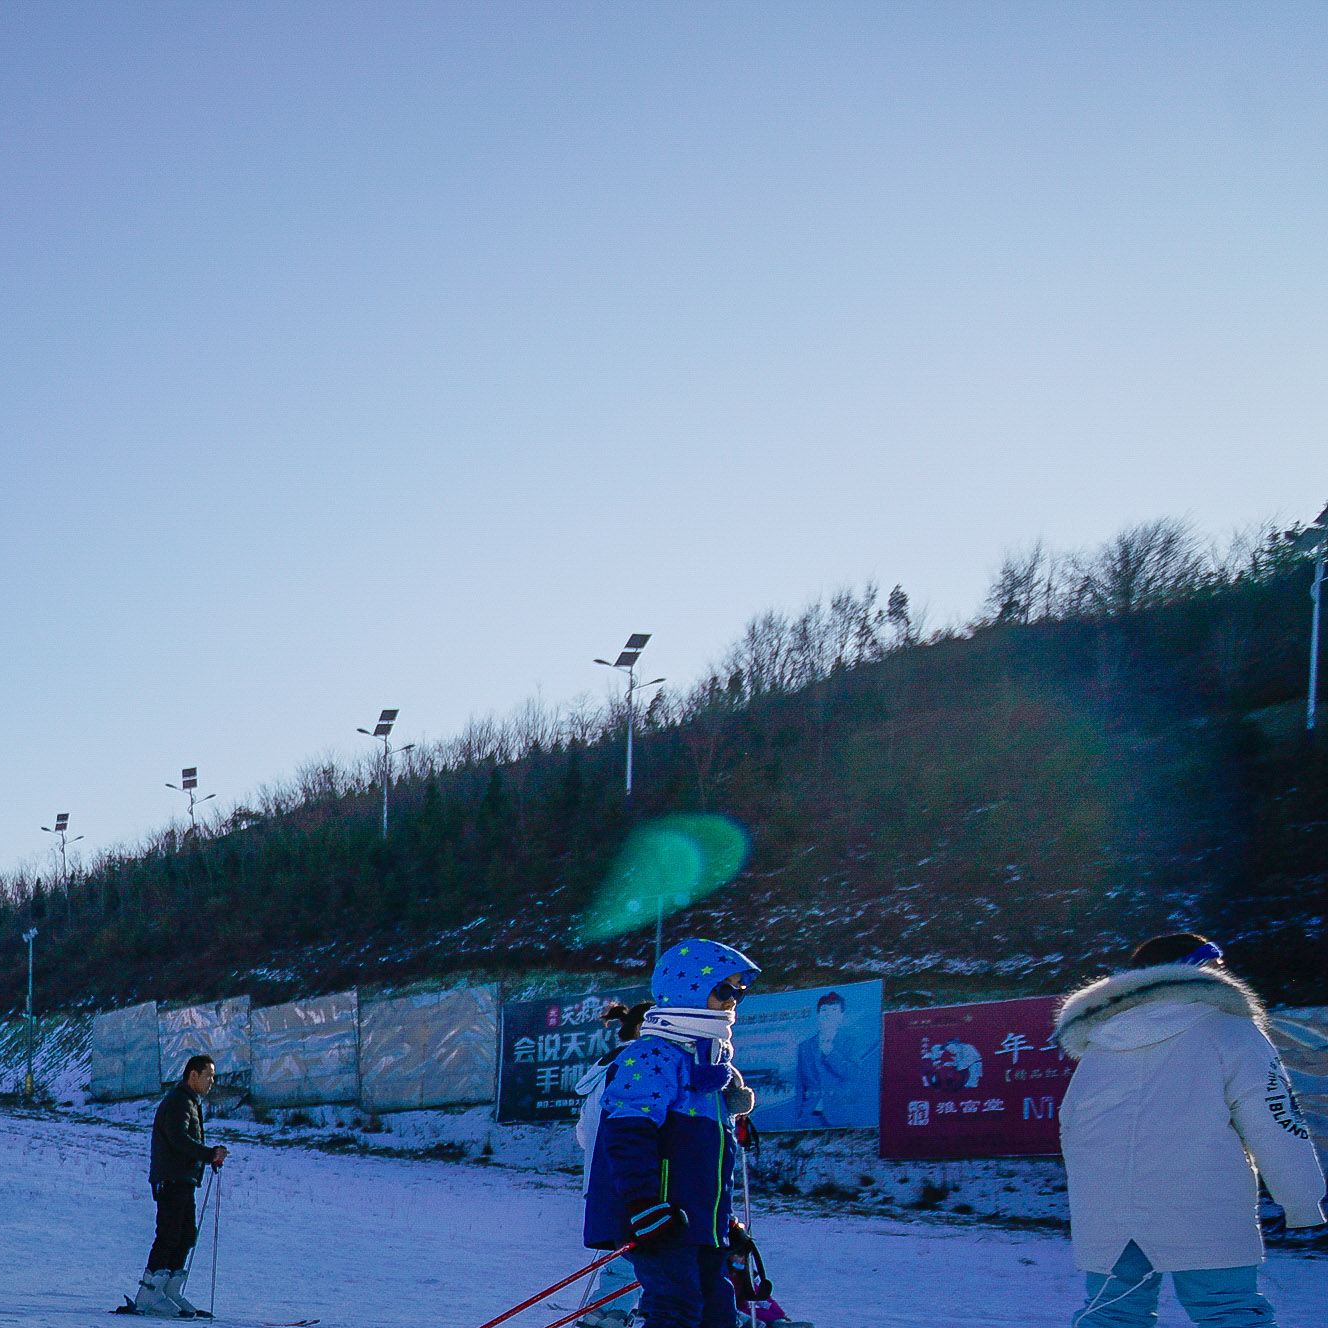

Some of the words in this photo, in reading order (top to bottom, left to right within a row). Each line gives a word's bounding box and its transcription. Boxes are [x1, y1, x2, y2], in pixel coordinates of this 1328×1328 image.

[513, 1027, 620, 1064] 会说天水
[536, 1063, 586, 1094] 手机
